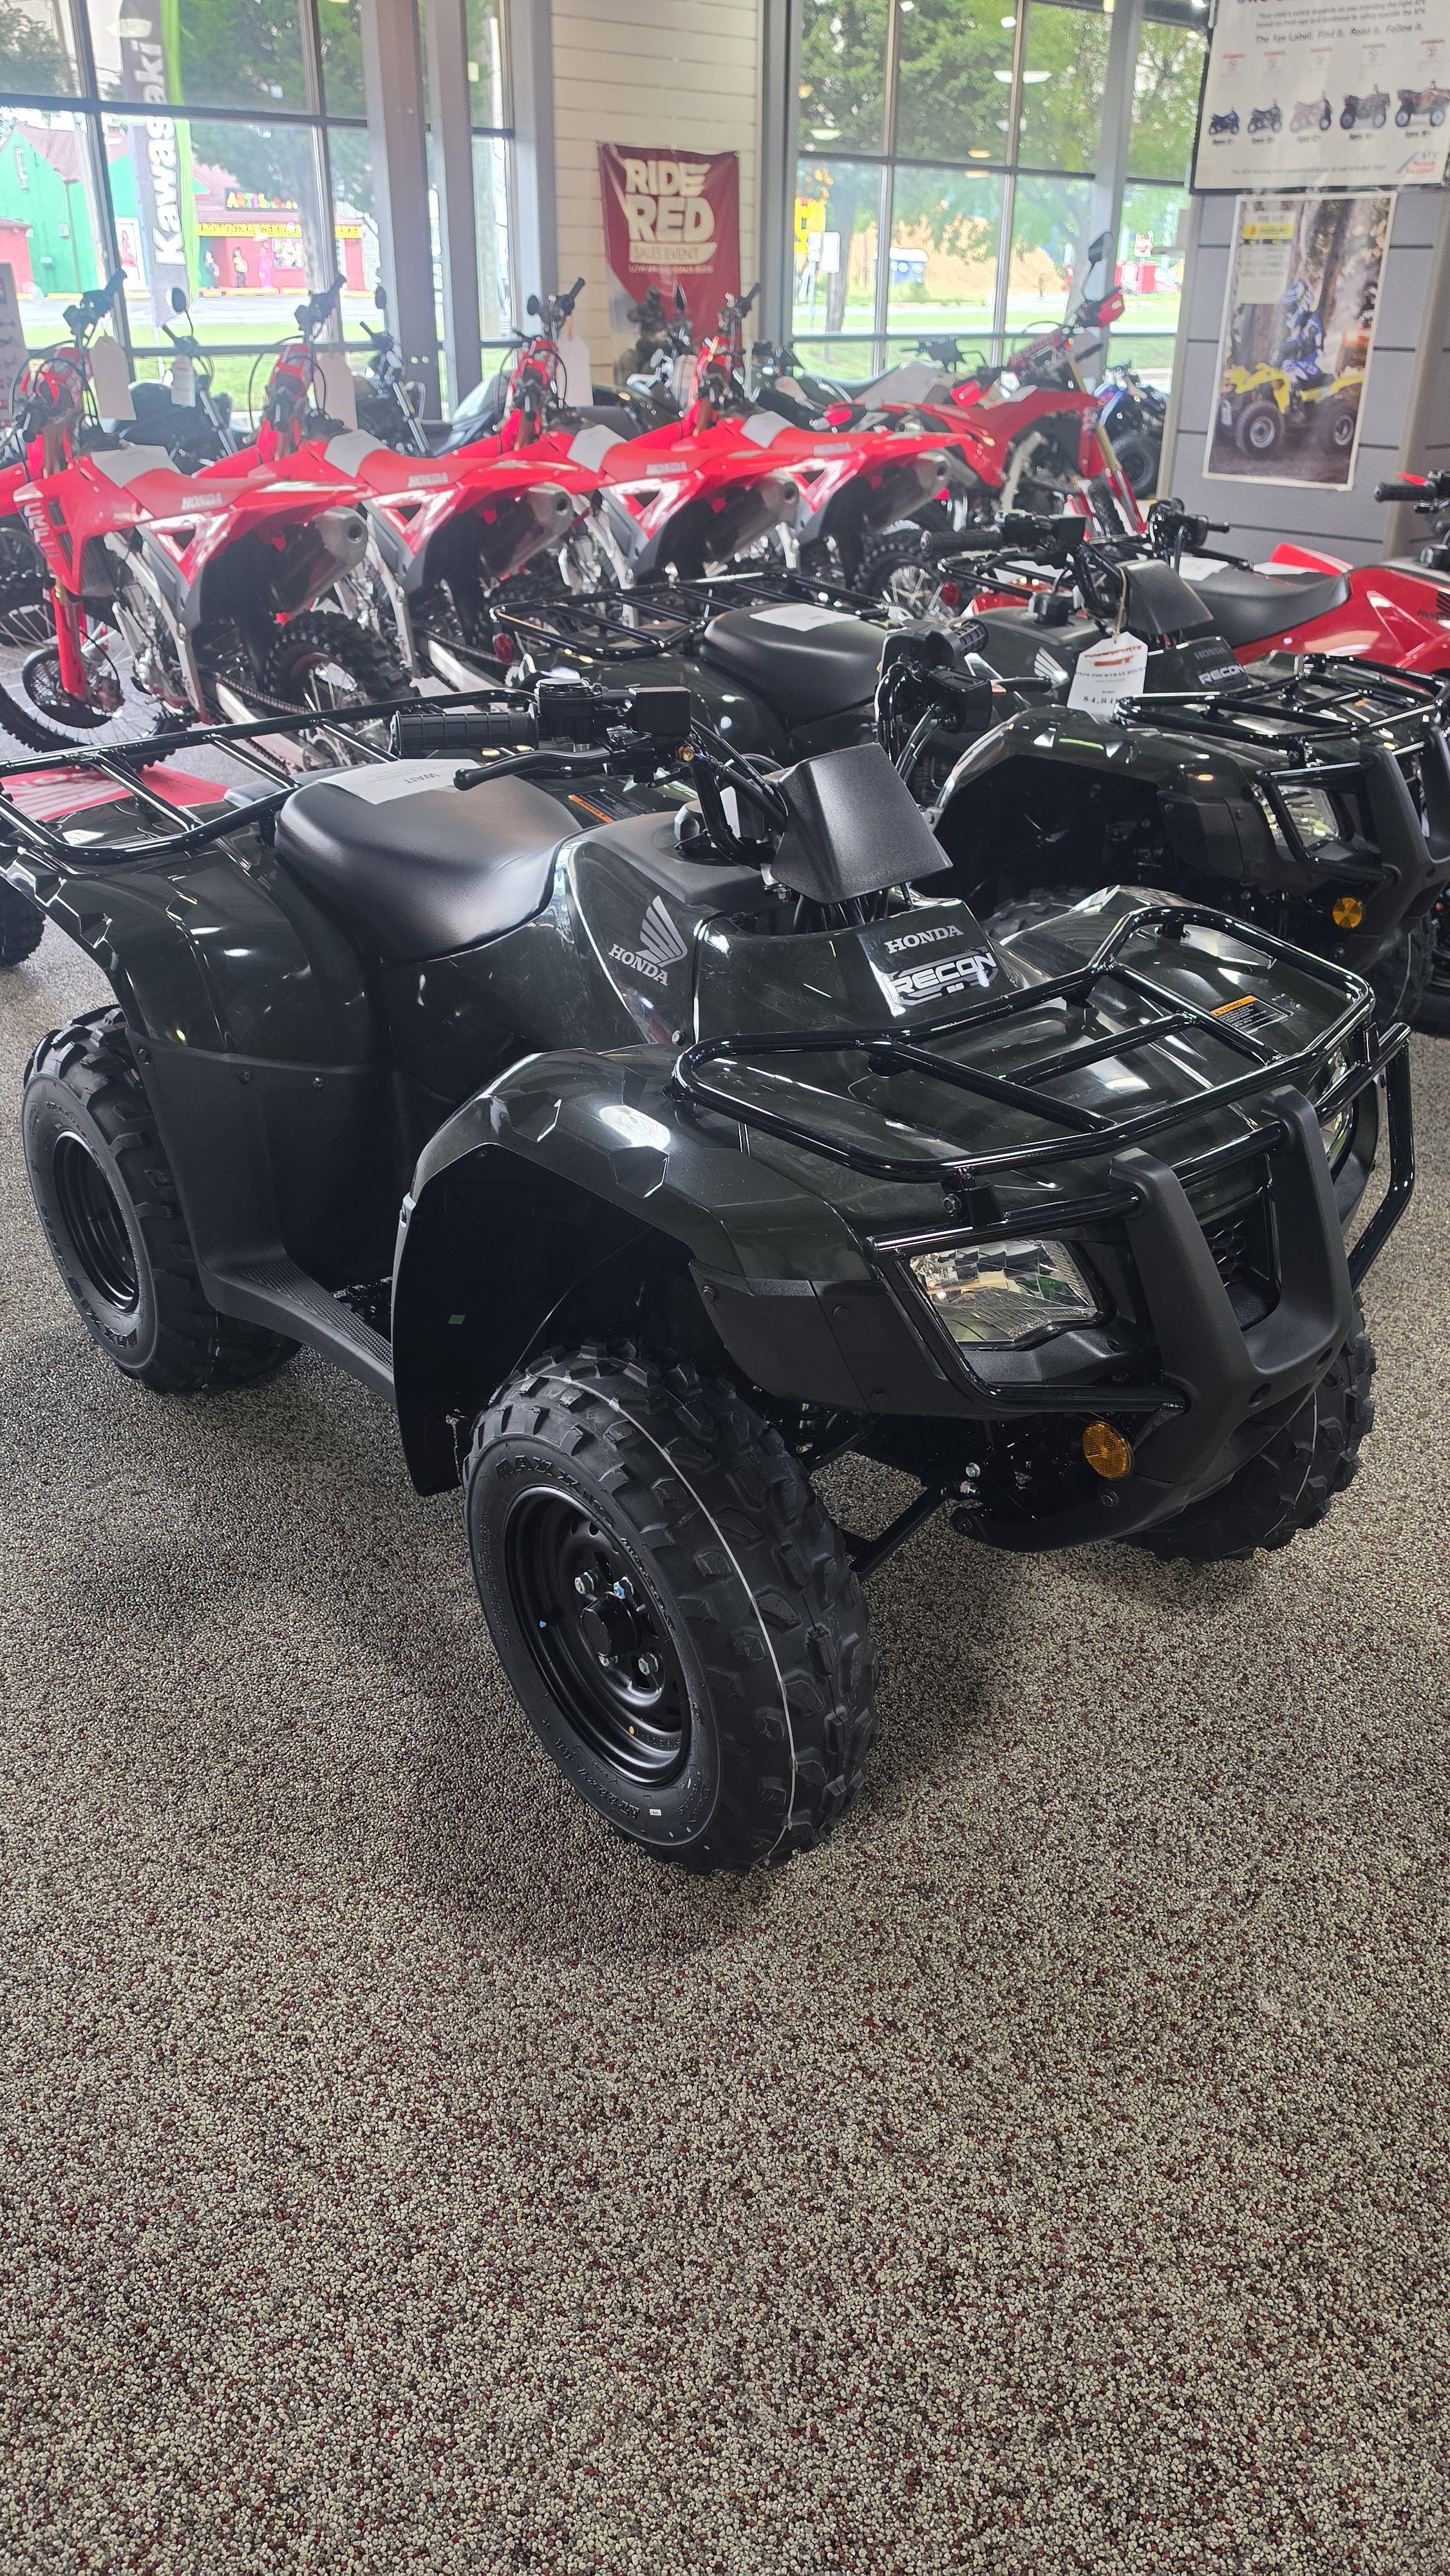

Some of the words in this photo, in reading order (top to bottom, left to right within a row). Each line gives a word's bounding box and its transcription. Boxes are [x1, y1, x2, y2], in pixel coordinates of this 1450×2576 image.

[624, 158, 711, 196] RIDE
[625, 194, 715, 242] RED
[664, 247, 699, 260] EVENT
[181, 493, 223, 511] HONDA
[1194, 646, 1229, 661] HONDA
[1198, 664, 1245, 685] RECON
[404, 773, 440, 784] WAIT
[884, 925, 964, 954] HONDA
[608, 943, 668, 987] HONDA
[891, 952, 997, 994] RECON
